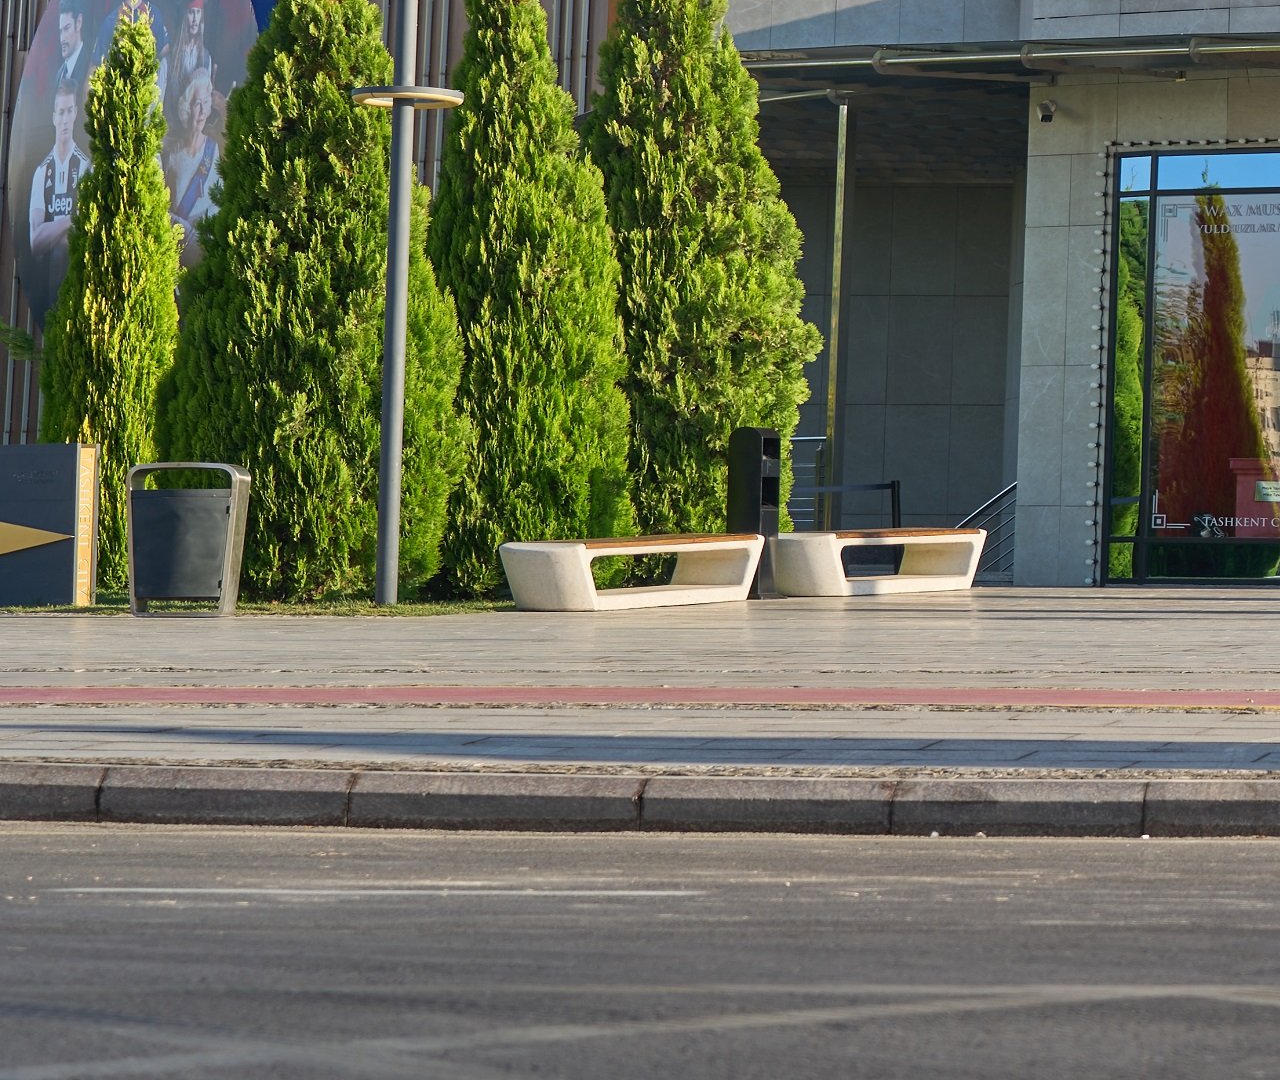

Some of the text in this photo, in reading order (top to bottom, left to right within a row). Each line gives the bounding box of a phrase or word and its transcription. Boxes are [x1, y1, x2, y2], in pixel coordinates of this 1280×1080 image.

[48, 194, 73, 215] Jeep
[1204, 204, 1243, 217] WAX
[78, 454, 93, 597] TASHKENT CITY
[1203, 516, 1268, 527] TASHKENT
